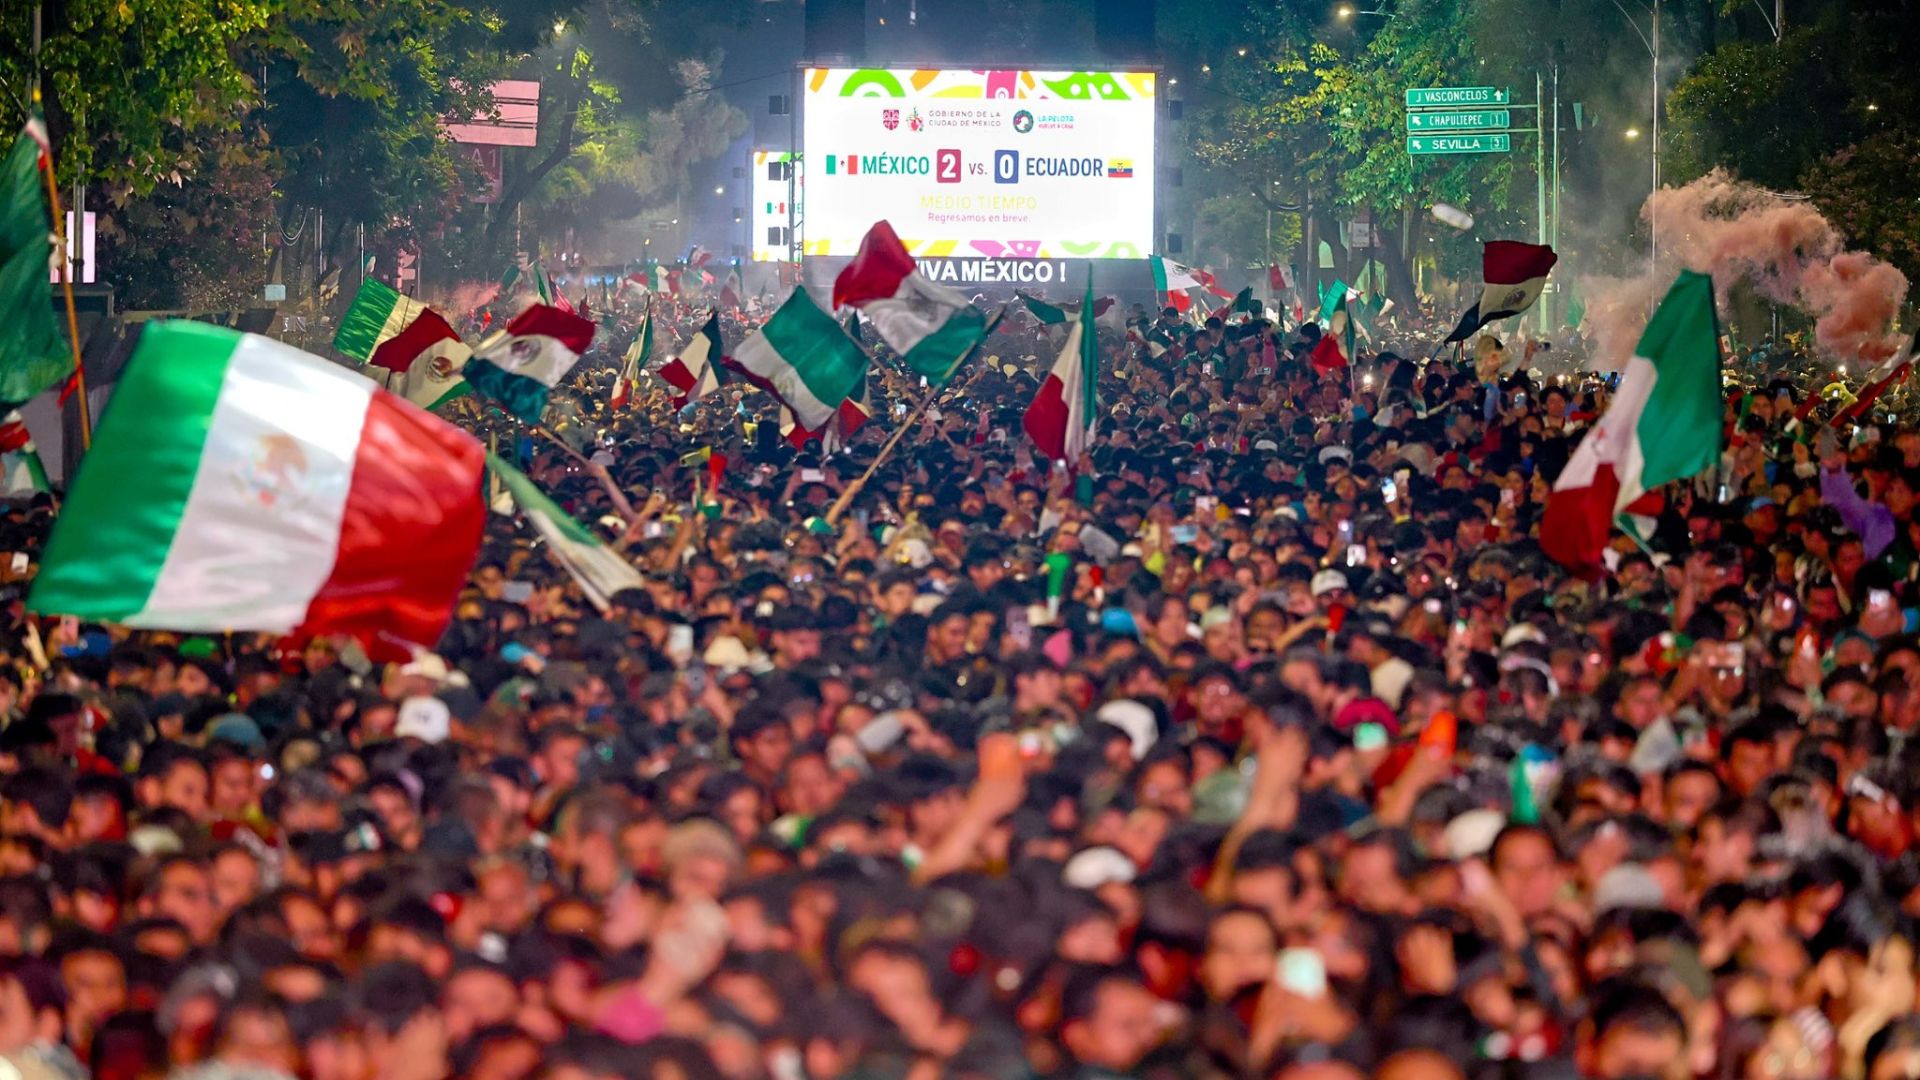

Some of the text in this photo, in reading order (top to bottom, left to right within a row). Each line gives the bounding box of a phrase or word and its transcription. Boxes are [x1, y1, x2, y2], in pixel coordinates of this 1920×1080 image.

[1416, 90, 1488, 103] J VASCONCELOS
[929, 119, 957, 127] CIUDAD
[960, 119, 970, 127] DE
[1429, 115, 1483, 126] CHAPULTEPEC
[1432, 138, 1499, 150] SEVILLA 3
[862, 152, 930, 175] MÉXICO
[941, 153, 957, 179] 2
[999, 153, 1015, 179] 0
[1026, 157, 1103, 177] ECUADOR
[920, 195, 1038, 210] MEDIO TIEMPO
[928, 212, 986, 224] Regresamos
[1002, 213, 1031, 222] breve.
[961, 256, 1053, 283] MÉXICO
